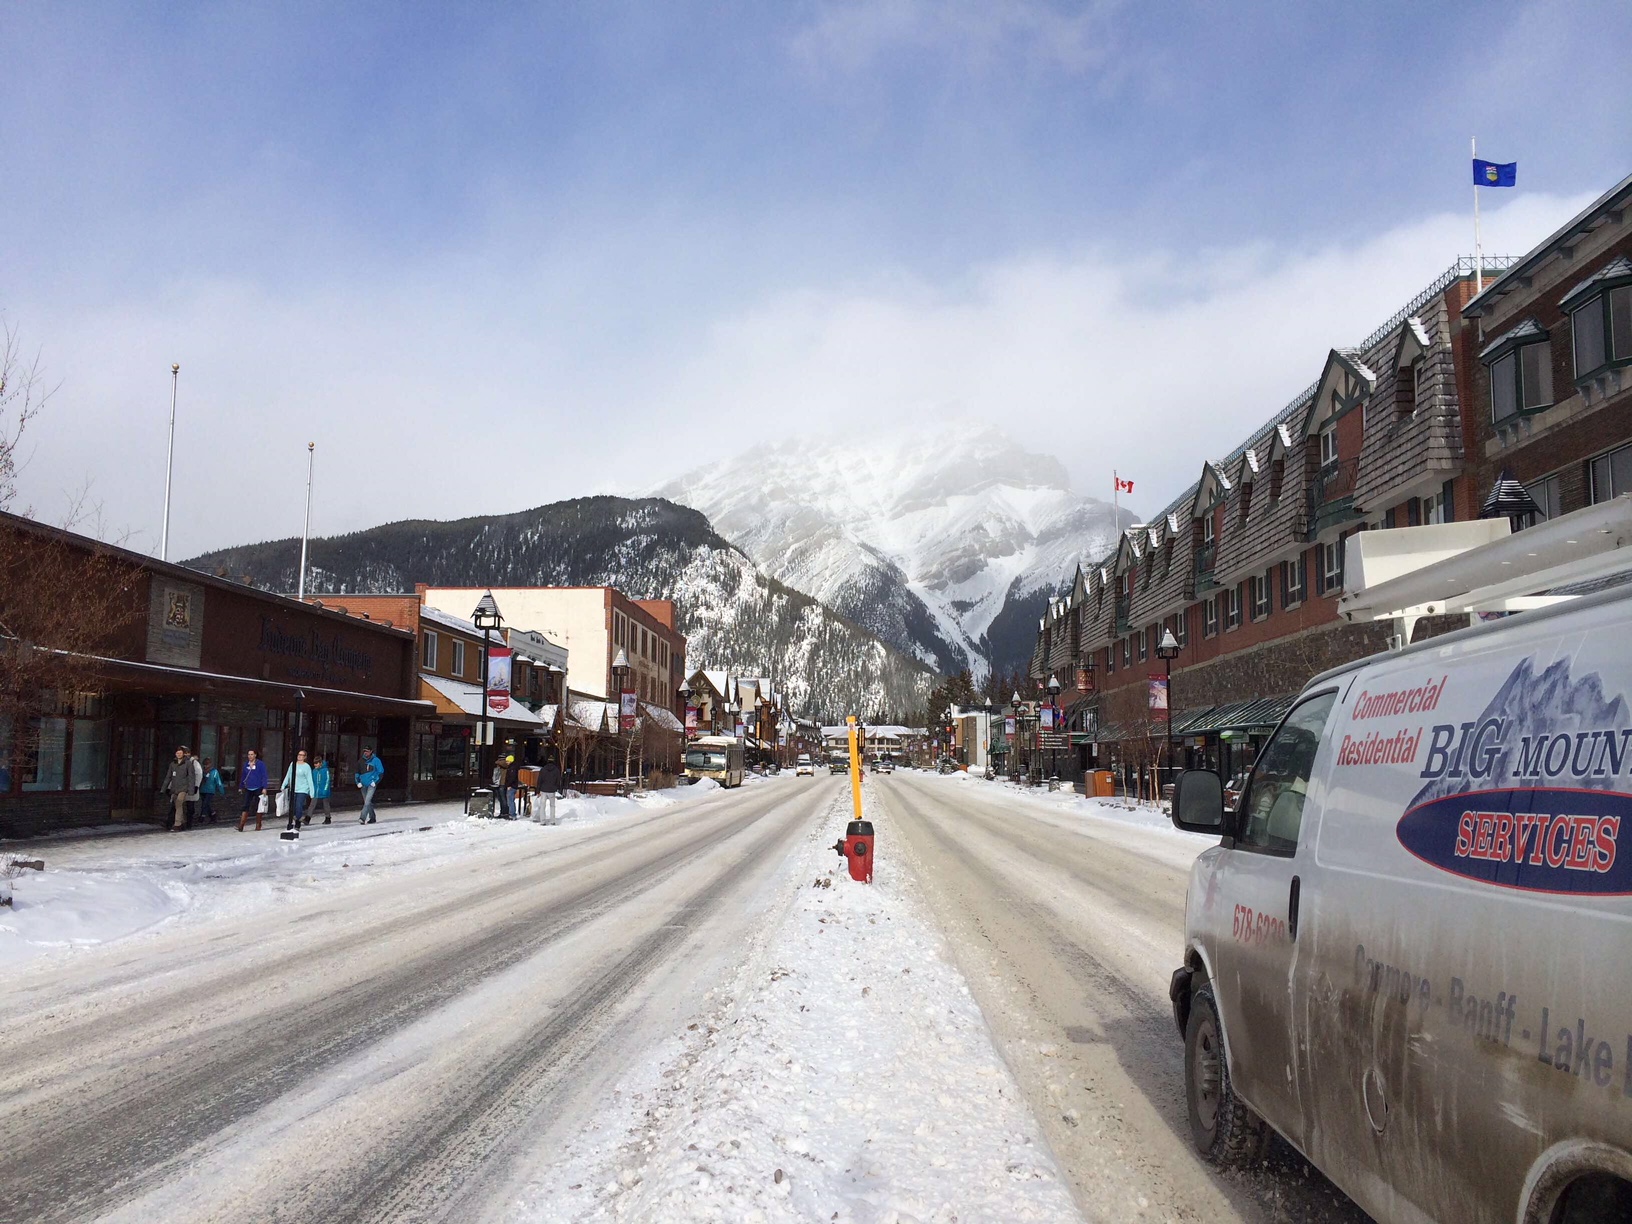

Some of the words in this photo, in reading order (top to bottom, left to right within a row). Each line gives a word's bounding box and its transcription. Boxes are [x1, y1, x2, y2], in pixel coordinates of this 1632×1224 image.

[309, 629, 331, 671] Bay
[333, 635, 374, 672] Company
[1352, 675, 1449, 721] Commercial
[1337, 727, 1423, 766] Residential
[1420, 717, 1505, 779] BIG
[1512, 729, 1632, 778] MOUN
[1455, 811, 1622, 873] SERVICES
[1354, 944, 1431, 1014] Canmore
[1447, 976, 1517, 1048] Banff
[1538, 1007, 1614, 1088] Lake
